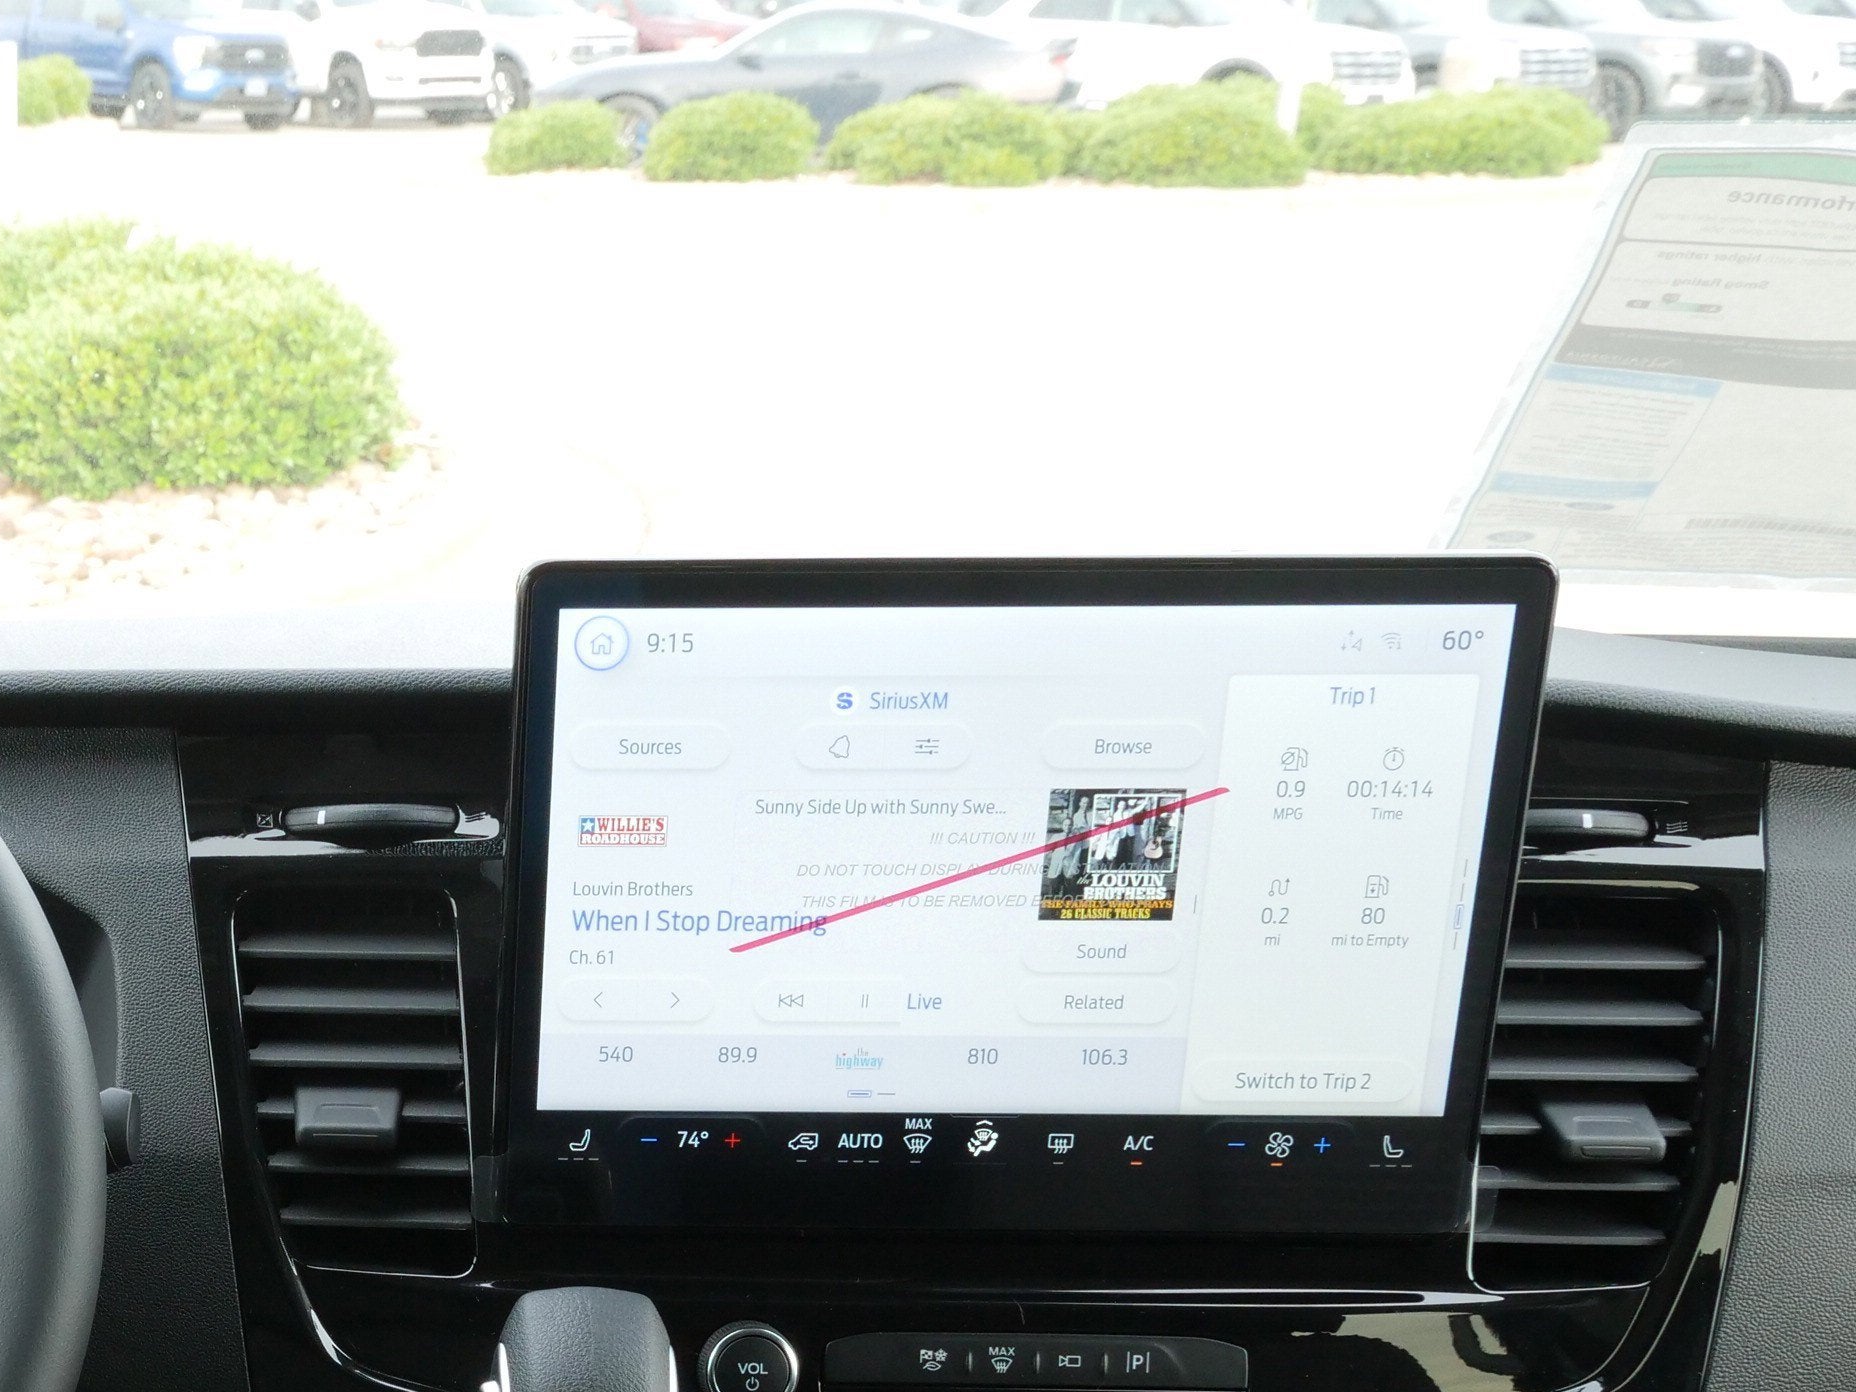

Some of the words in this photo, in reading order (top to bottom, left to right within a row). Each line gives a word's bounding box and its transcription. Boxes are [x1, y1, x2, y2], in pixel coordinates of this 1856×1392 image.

[646, 632, 694, 653] 9:15
[1441, 629, 1485, 651] 60°
[868, 690, 949, 711] SiriusXM
[1329, 686, 1362, 708] Trip
[1370, 686, 1377, 704] 1
[618, 737, 683, 756] Sources
[1093, 737, 1153, 755] Browse
[1276, 779, 1305, 797] 0.9
[1347, 779, 1434, 798] 00:14:14
[754, 798, 804, 818] Sunny
[806, 798, 842, 815] Side
[844, 799, 866, 819] Up
[869, 798, 907, 815] with
[909, 798, 959, 818] Sunny
[961, 798, 1007, 815] Swe...
[1272, 806, 1304, 821] MPG
[1370, 806, 1404, 821] Time
[596, 817, 665, 832] WILLIE'S
[580, 833, 665, 845] ROADHOUSE
[947, 831, 1019, 845] CAUTION
[796, 863, 821, 877] DO
[824, 863, 859, 877] NOT
[862, 863, 916, 877] TOUCH
[572, 880, 625, 897] Louvin
[627, 880, 693, 897] Brothers
[1091, 873, 1166, 887] LOUVIN
[801, 895, 836, 908] THIS
[924, 895, 945, 908] BE
[947, 894, 1028, 908] REMOVED
[1083, 886, 1168, 900] BROTHERS
[1074, 908, 1113, 919] CLASSIC
[1114, 908, 1152, 919] TRACKS
[1260, 907, 1290, 925] 0.2
[1360, 907, 1386, 925] 80
[572, 910, 637, 932] When
[643, 910, 650, 932] I
[656, 910, 711, 936] Stop
[717, 910, 828, 937] Dreaming
[1264, 933, 1281, 947] mi
[1331, 933, 1348, 947] mi
[1350, 934, 1364, 947] to
[1366, 934, 1410, 949] Empty
[568, 949, 592, 965] Ch.
[596, 949, 616, 965] 61
[1076, 943, 1127, 960] Sound
[907, 993, 942, 1011] Live
[1063, 994, 1125, 1011] Related
[598, 1046, 634, 1063] 540
[717, 1046, 758, 1063] 89.9
[835, 1053, 884, 1070] highway
[967, 1048, 999, 1065] 810
[1080, 1048, 1129, 1066] 106.3
[1234, 1072, 1296, 1090] Switch
[1300, 1075, 1317, 1090] to
[1323, 1073, 1358, 1093] Trip
[1360, 1073, 1372, 1091] 2
[904, 1118, 932, 1130] MAX
[677, 1130, 710, 1149] 74°
[837, 1132, 883, 1149] AUTO
[1123, 1135, 1154, 1152] A/C
[988, 1346, 1016, 1357] MAX
[738, 1363, 769, 1376] VOL
